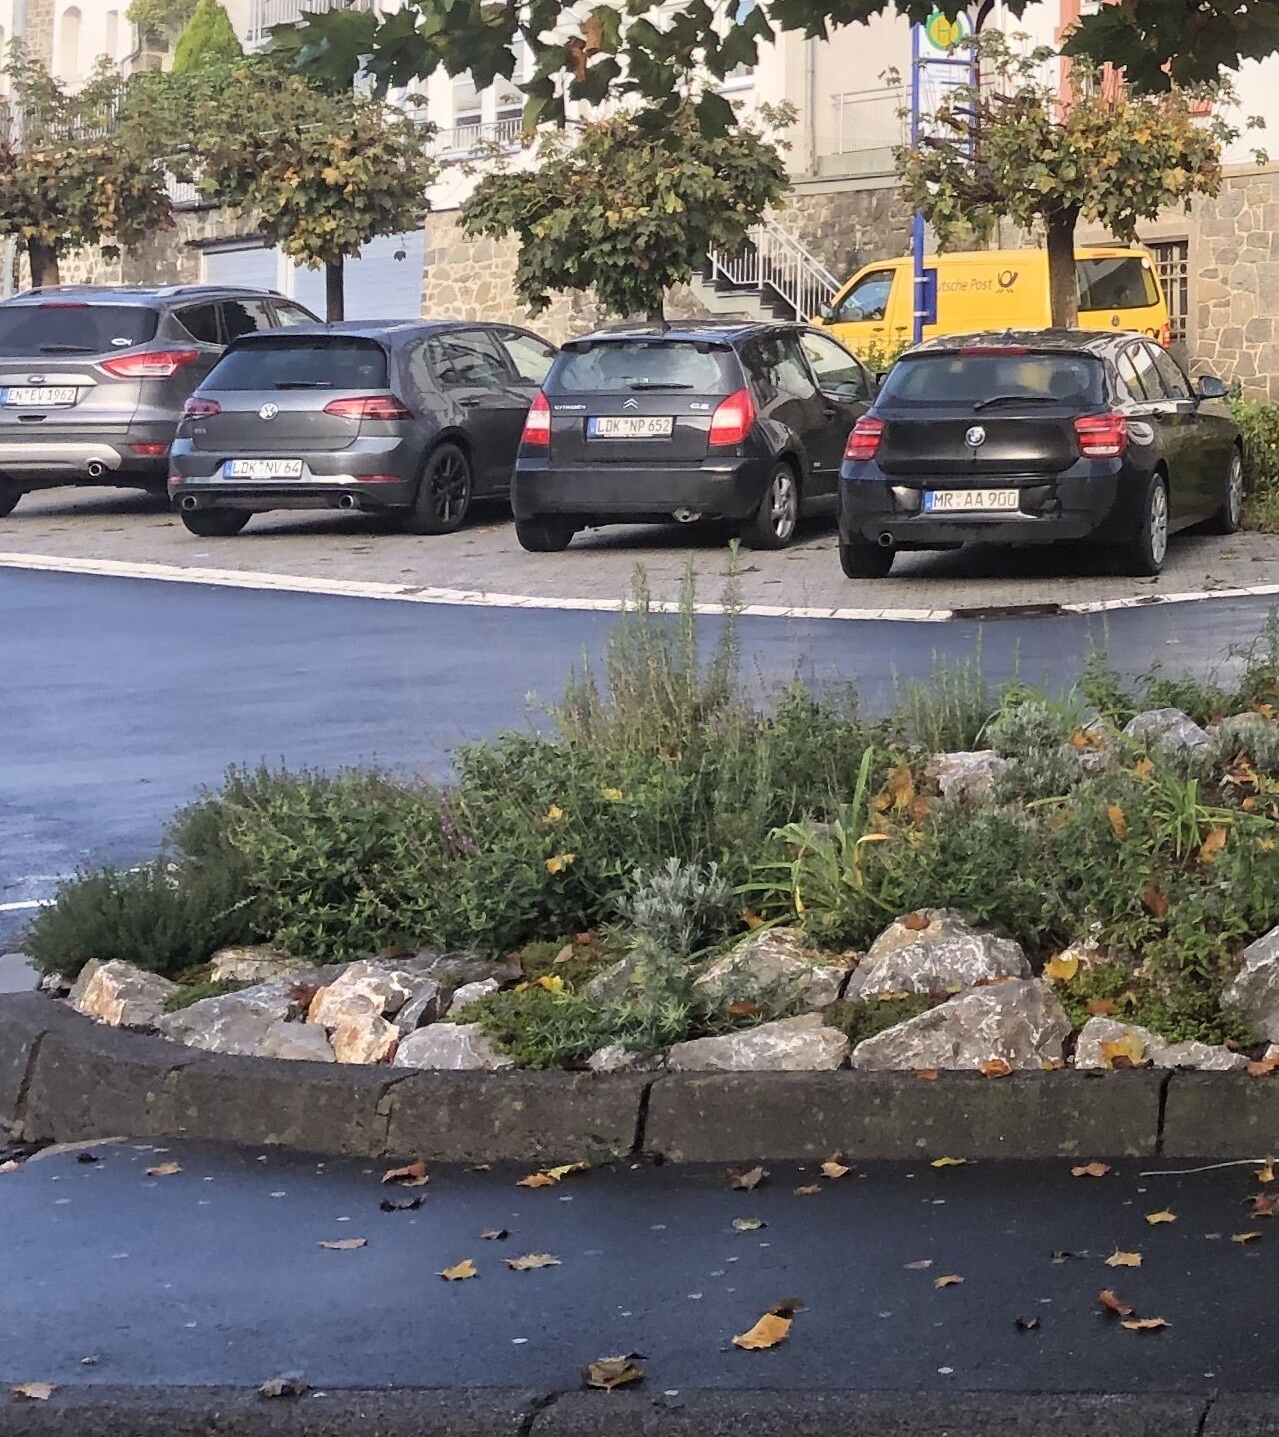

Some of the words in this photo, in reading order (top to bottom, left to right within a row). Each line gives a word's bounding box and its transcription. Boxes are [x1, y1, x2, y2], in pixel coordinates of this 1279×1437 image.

[970, 278, 993, 291] Post
[650, 419, 670, 432] 652
[283, 461, 299, 473] 64
[934, 493, 954, 508] MR
[964, 492, 984, 507] AA
[988, 492, 1017, 507] 900
